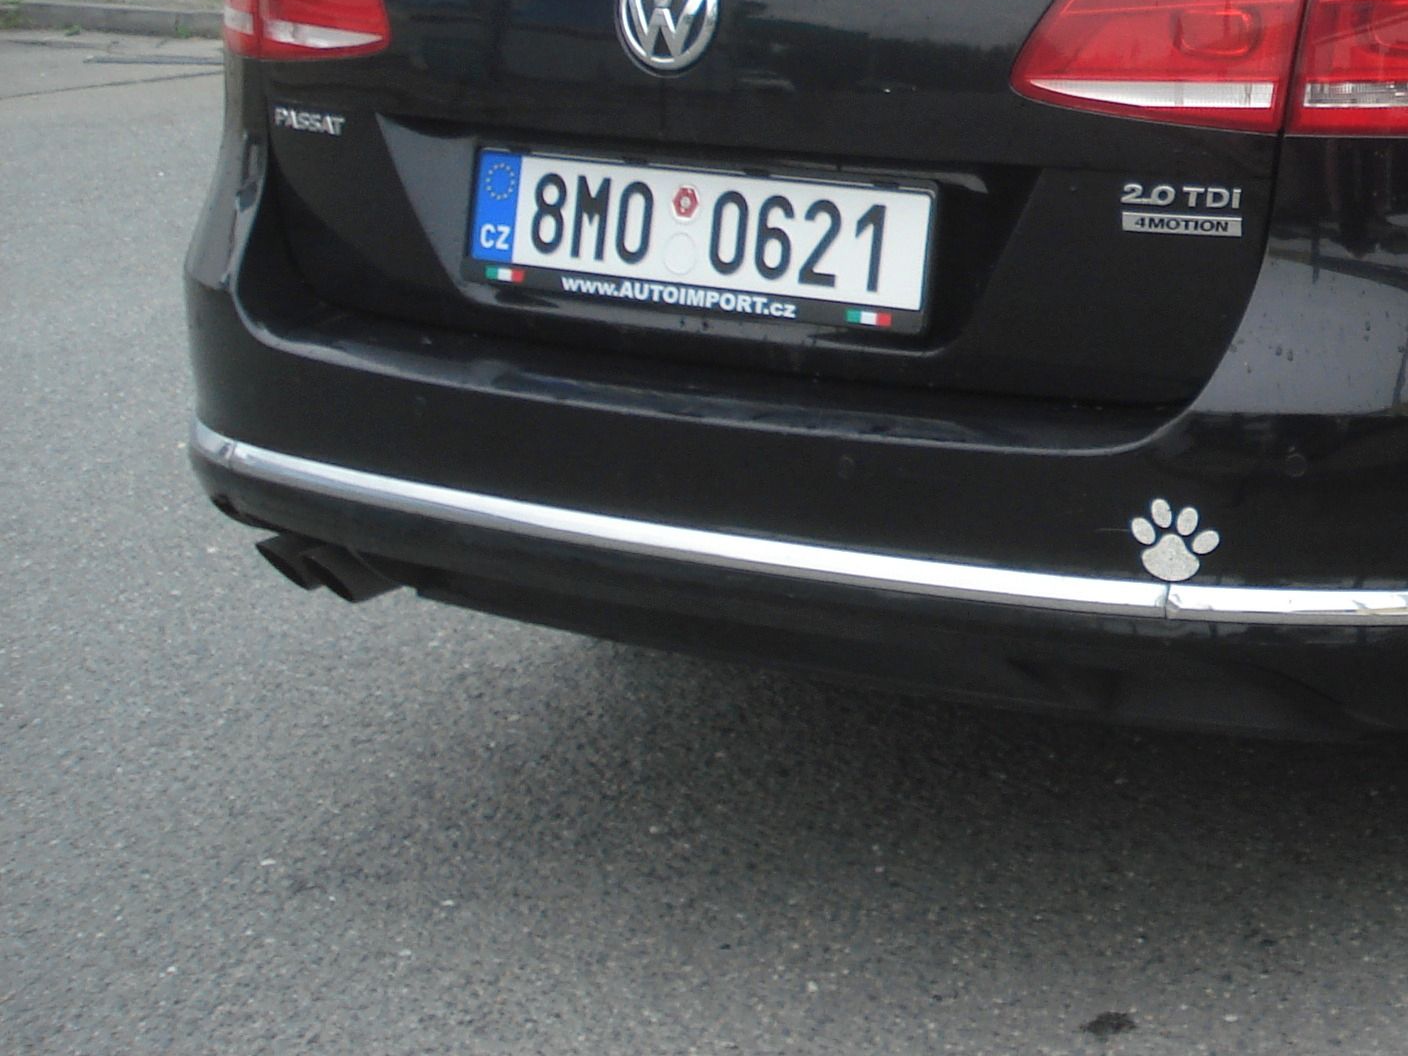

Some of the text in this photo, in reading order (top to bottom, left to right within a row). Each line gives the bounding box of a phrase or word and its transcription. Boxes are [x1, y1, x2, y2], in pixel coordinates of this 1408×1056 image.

[274, 107, 345, 136] PASSAT
[1120, 183, 1242, 209] 2.0 TDI
[480, 224, 510, 252] CZ
[1134, 217, 1229, 233] 4MOTION
[709, 190, 888, 293] 0621
[562, 275, 796, 319] www.AUTOIMPORT.cz
